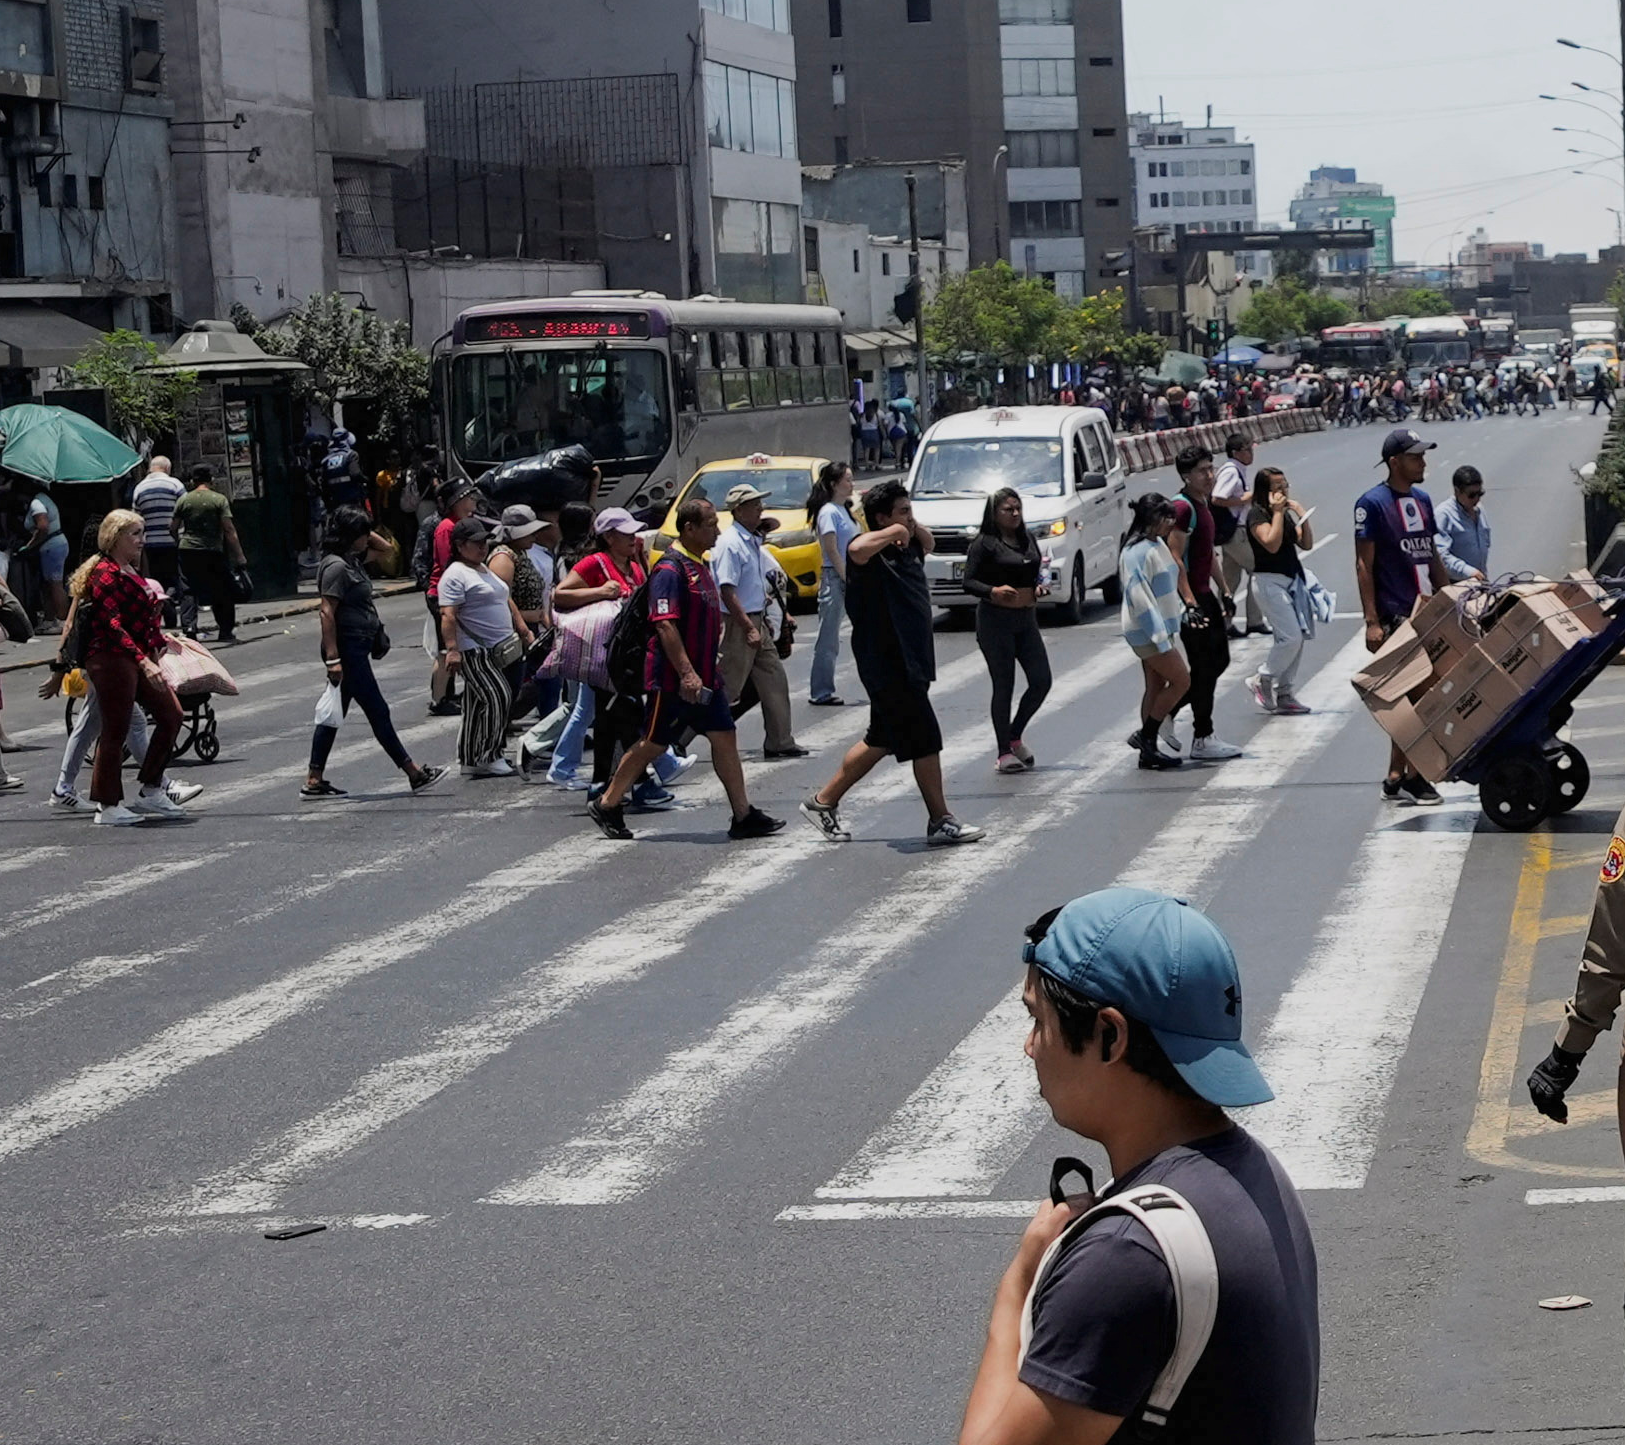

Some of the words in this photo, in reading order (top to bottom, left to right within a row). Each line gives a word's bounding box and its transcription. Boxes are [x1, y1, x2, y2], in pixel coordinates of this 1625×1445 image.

[751, 456, 768, 465] TAXI
[1399, 536, 1432, 554] QATAR
[1501, 647, 1523, 670] Angel
[1455, 692, 1478, 715] Angel
